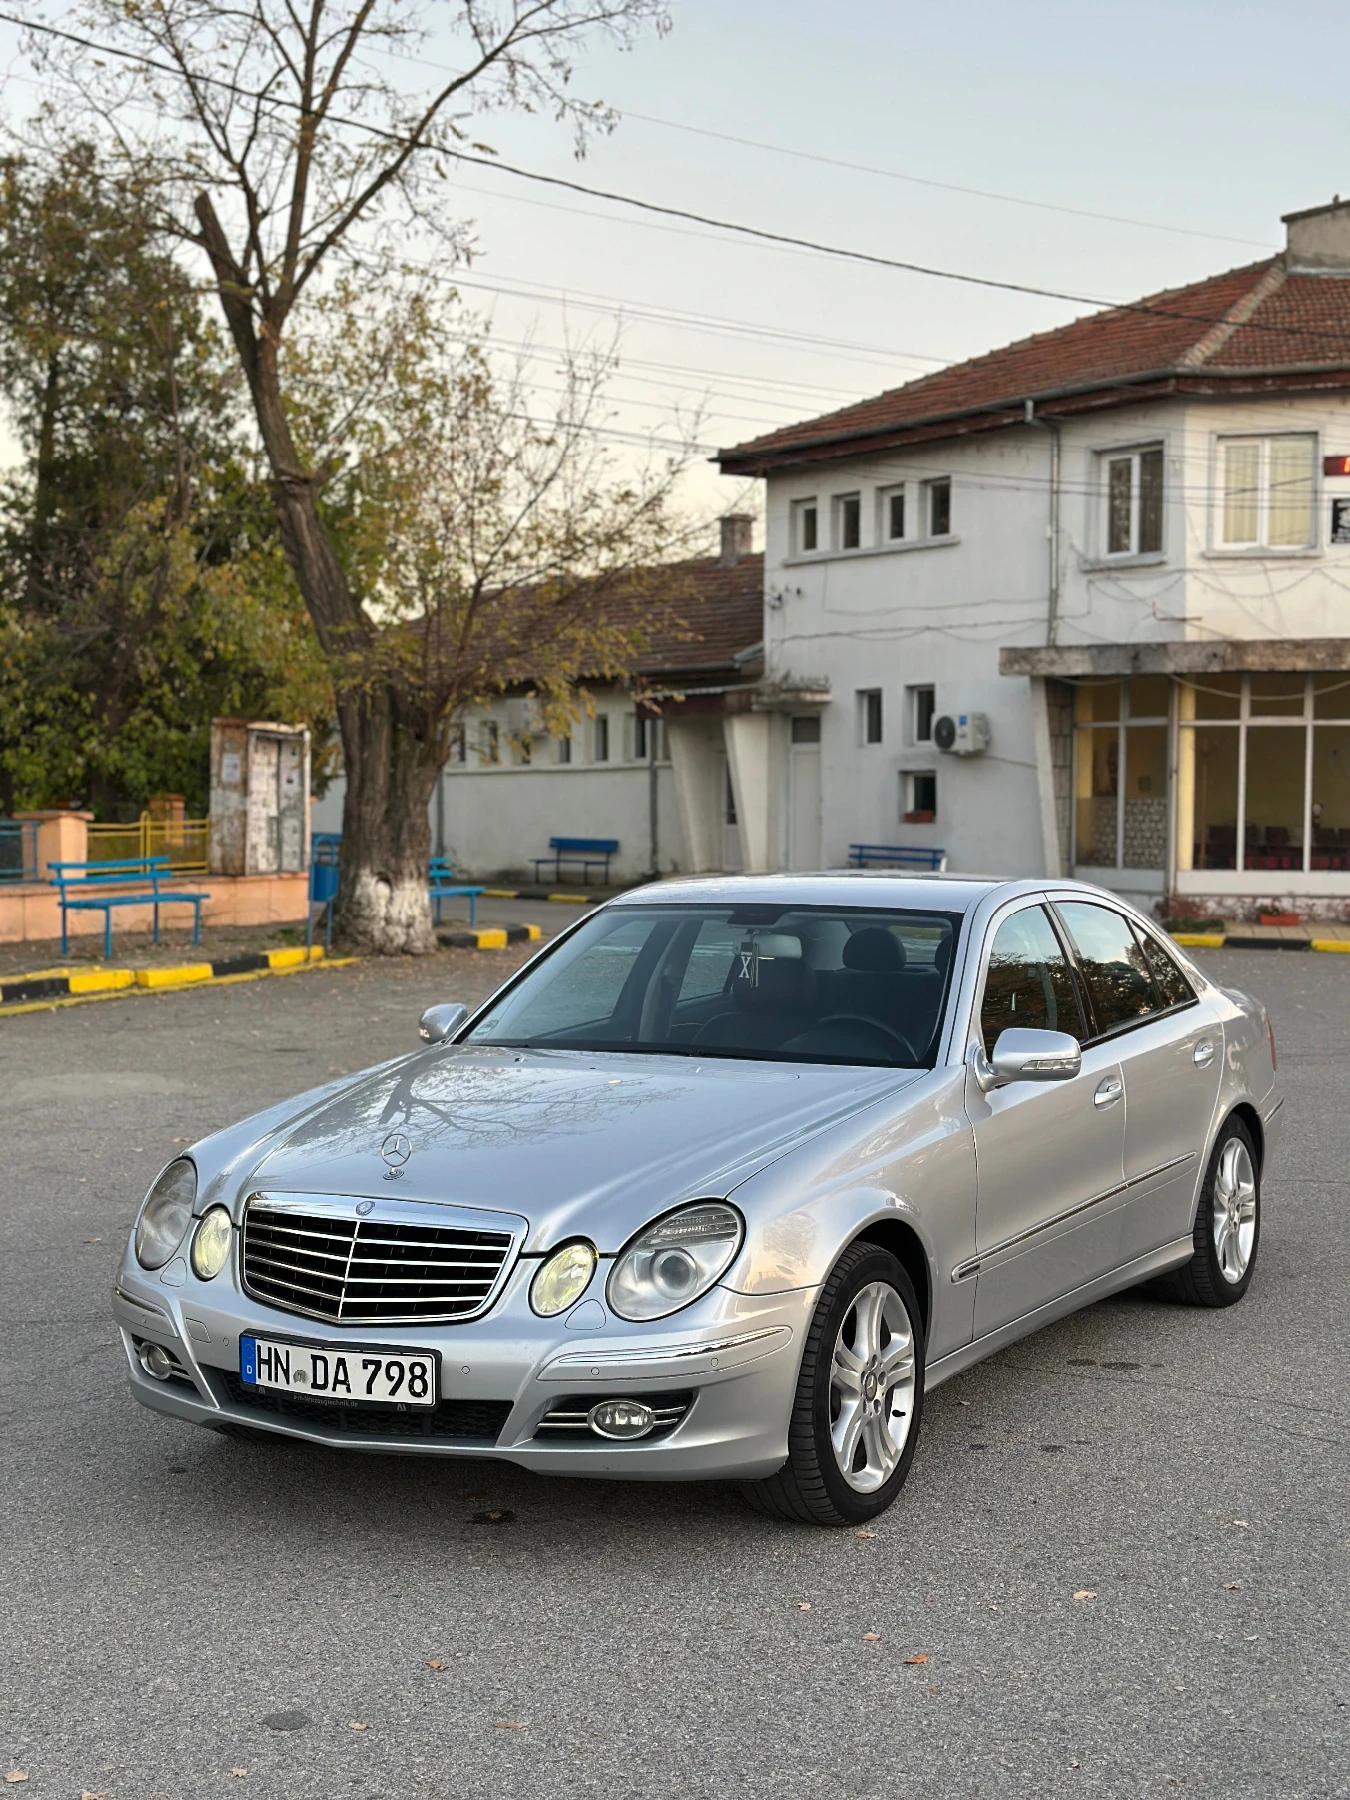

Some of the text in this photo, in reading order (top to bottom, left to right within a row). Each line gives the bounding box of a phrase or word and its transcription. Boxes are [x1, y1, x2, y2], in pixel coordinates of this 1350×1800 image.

[246, 1364, 253, 1375] D
[257, 1344, 429, 1398] HN DA 798
